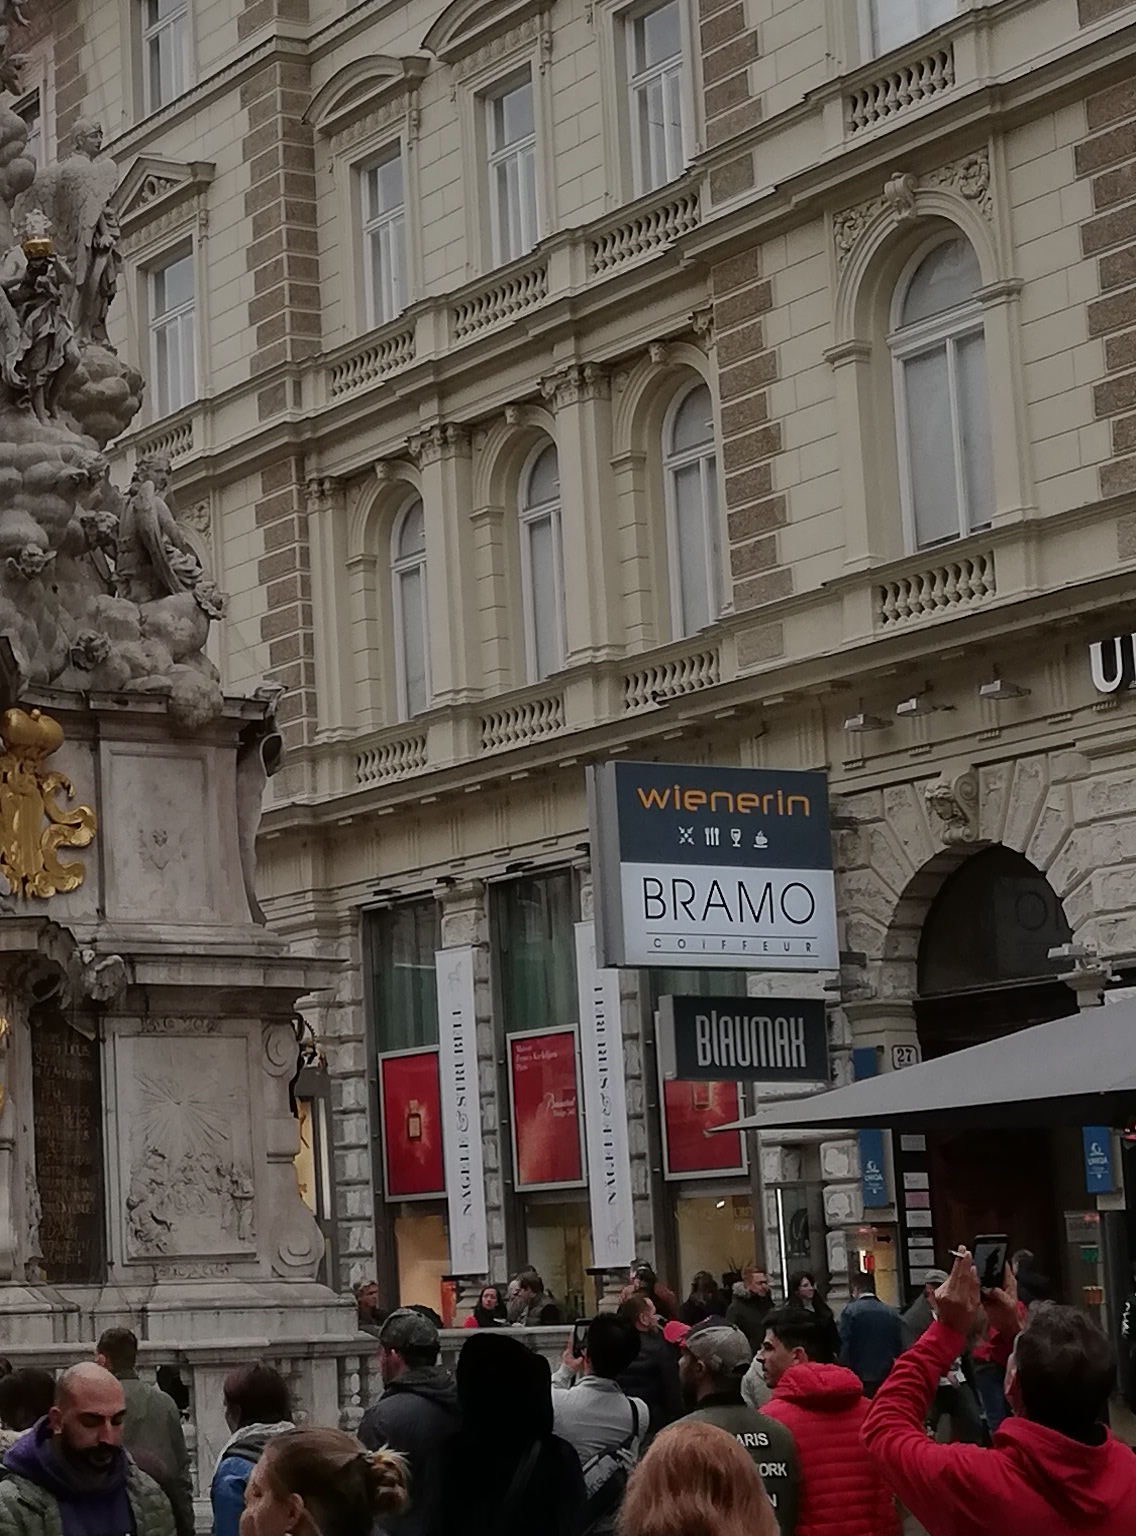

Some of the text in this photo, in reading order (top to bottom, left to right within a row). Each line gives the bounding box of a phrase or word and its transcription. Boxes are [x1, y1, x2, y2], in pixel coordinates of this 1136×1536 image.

[1089, 632, 1136, 693] U
[637, 783, 811, 817] wienerin
[642, 877, 816, 924] BRAMO
[653, 937, 813, 953] COIFFEUR
[896, 1047, 914, 1063] 27
[736, 1432, 769, 1446] ARIS
[759, 1462, 788, 1477] ORK
